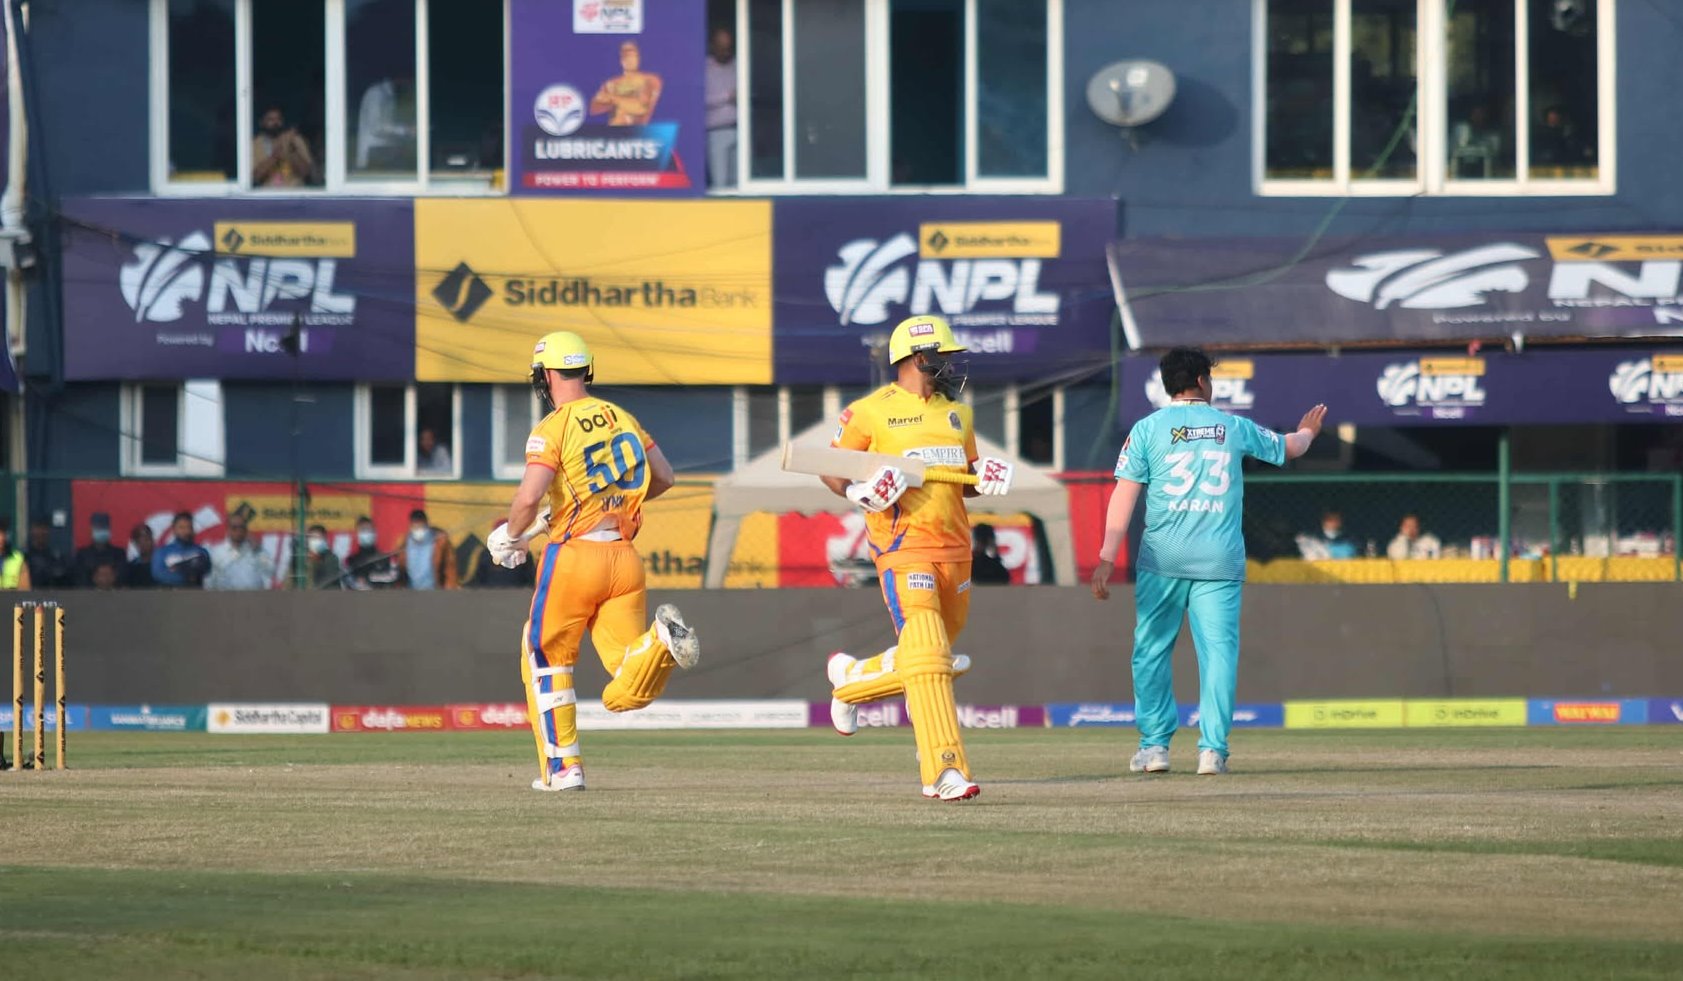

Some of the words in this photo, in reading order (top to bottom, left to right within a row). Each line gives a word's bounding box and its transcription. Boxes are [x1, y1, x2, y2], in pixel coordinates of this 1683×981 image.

[535, 139, 658, 160] LUBRICANTS
[535, 173, 579, 186] POWER
[580, 173, 598, 186] TO
[600, 173, 659, 186] PERFORM
[250, 235, 325, 246] Siddhartha
[207, 258, 356, 313] NPL
[505, 280, 697, 307] Siddhartha
[700, 287, 757, 309] Bank
[910, 258, 1060, 315] NPL
[208, 313, 246, 325] NEPAL
[1008, 315, 1058, 326] LEAGUE
[246, 330, 309, 352] Ncl
[1211, 379, 1255, 404] PL
[1416, 375, 1486, 402] NPL
[576, 405, 618, 433] baji
[888, 414, 924, 426] Marvel
[1187, 426, 1215, 437] XTREME
[583, 432, 646, 493] 50
[1162, 450, 1231, 496] 33
[1168, 500, 1224, 513] KARAN
[234, 709, 286, 724] Siddhartha
[288, 709, 322, 725] Capital
[856, 703, 900, 727] cell
